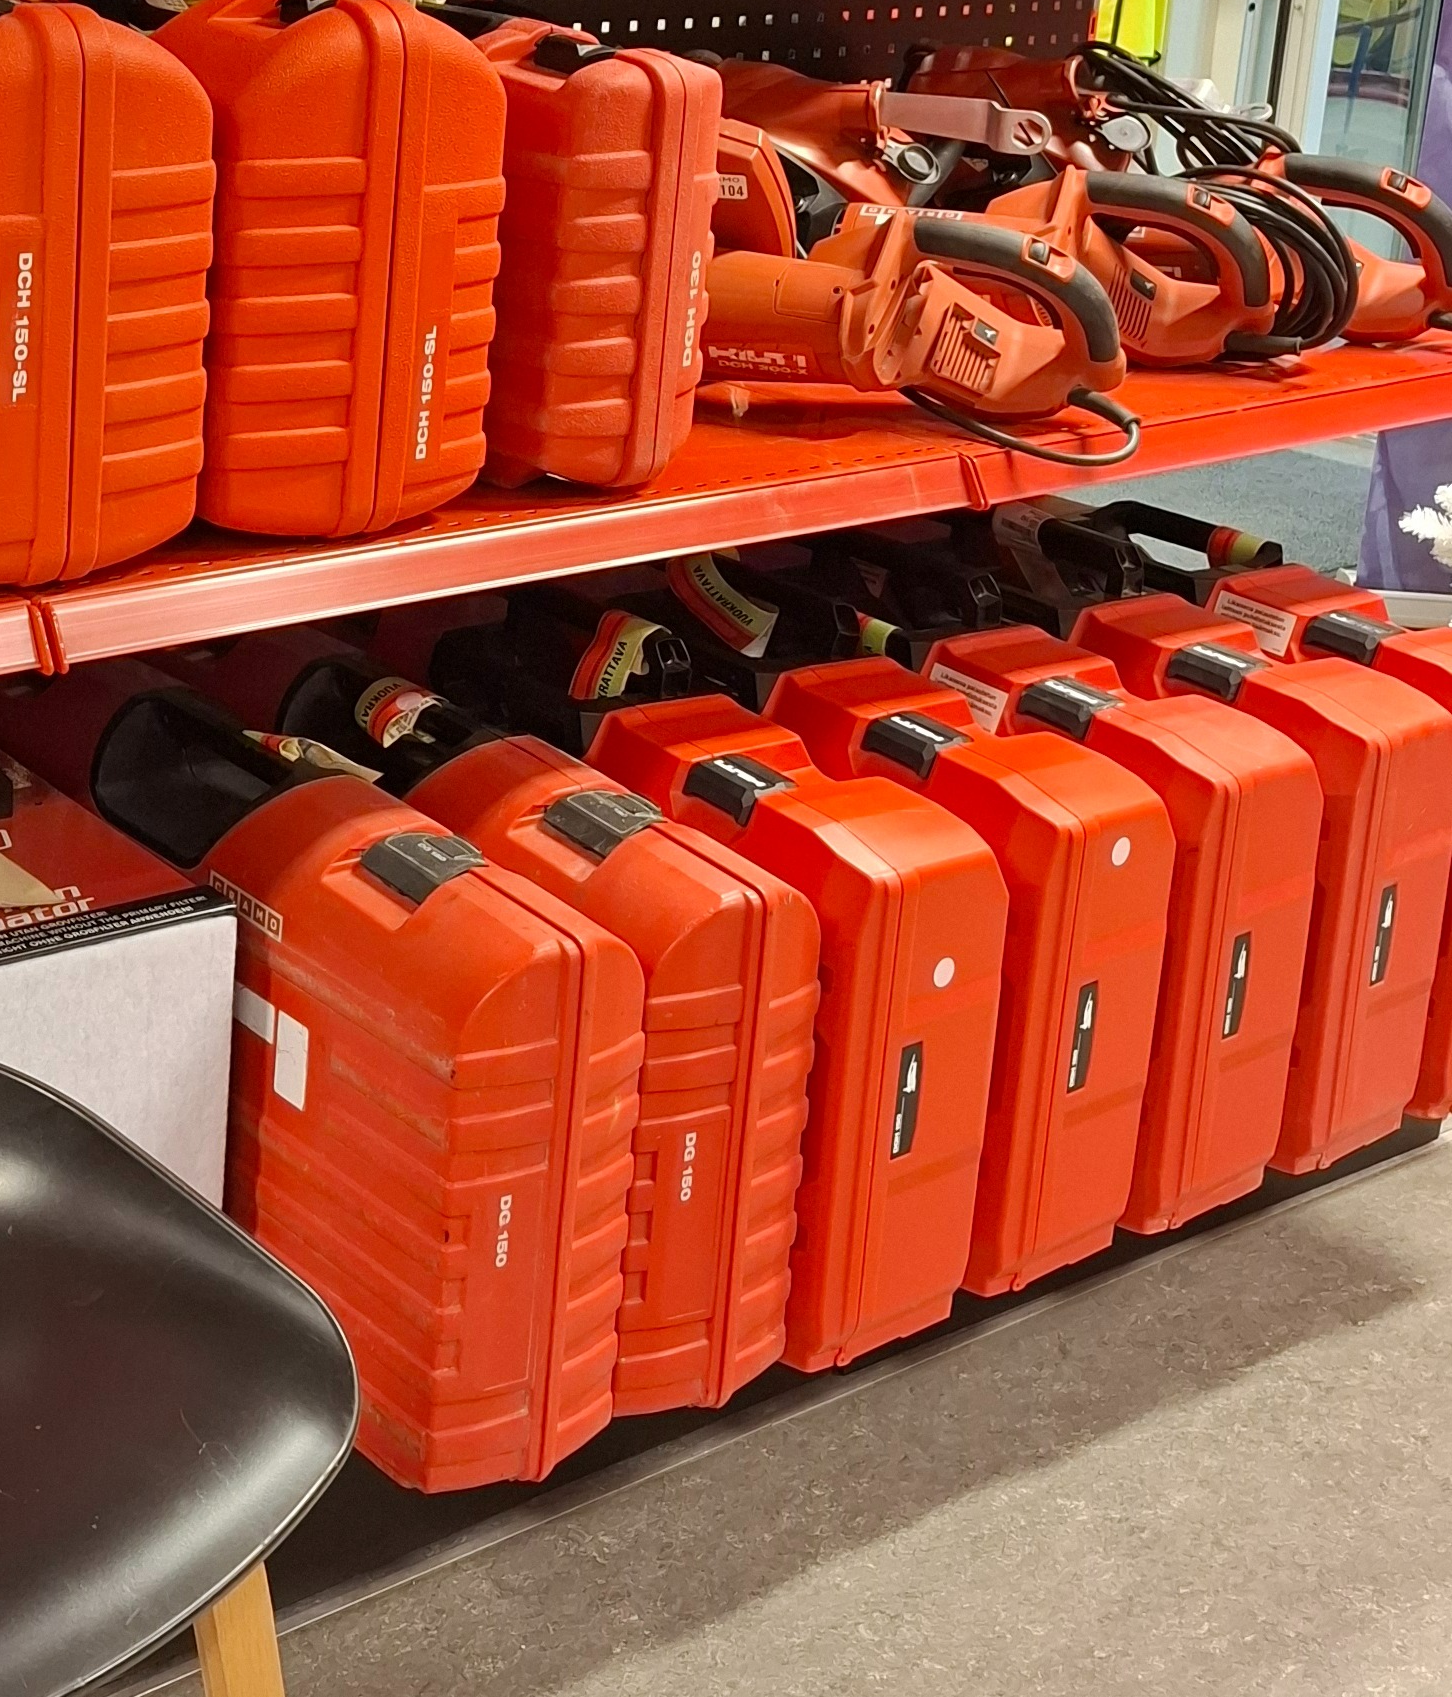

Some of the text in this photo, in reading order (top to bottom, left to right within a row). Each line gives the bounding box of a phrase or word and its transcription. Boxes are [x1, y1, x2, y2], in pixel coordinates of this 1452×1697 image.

[719, 176, 740, 184] MO
[721, 185, 744, 197] 104
[12, 253, 33, 403] DCH 150-SL
[682, 250, 702, 368] DGH 130
[415, 325, 437, 460] DCH 150-SL
[693, 564, 754, 627] VUOKRATTAVA
[0, 931, 48, 948] MACHINE
[48, 921, 99, 936] WITHOUT
[98, 913, 122, 924] THE
[122, 903, 168, 919] PRIMARY
[169, 895, 208, 909] FILTER!
[10, 926, 39, 938] UTAN
[40, 910, 109, 930] GROVFILTER!
[29, 935, 60, 947] OHNE
[129, 906, 194, 925] ANWENDEN!
[680, 1131, 697, 1202] DG 150
[495, 1194, 513, 1268] DG 150
